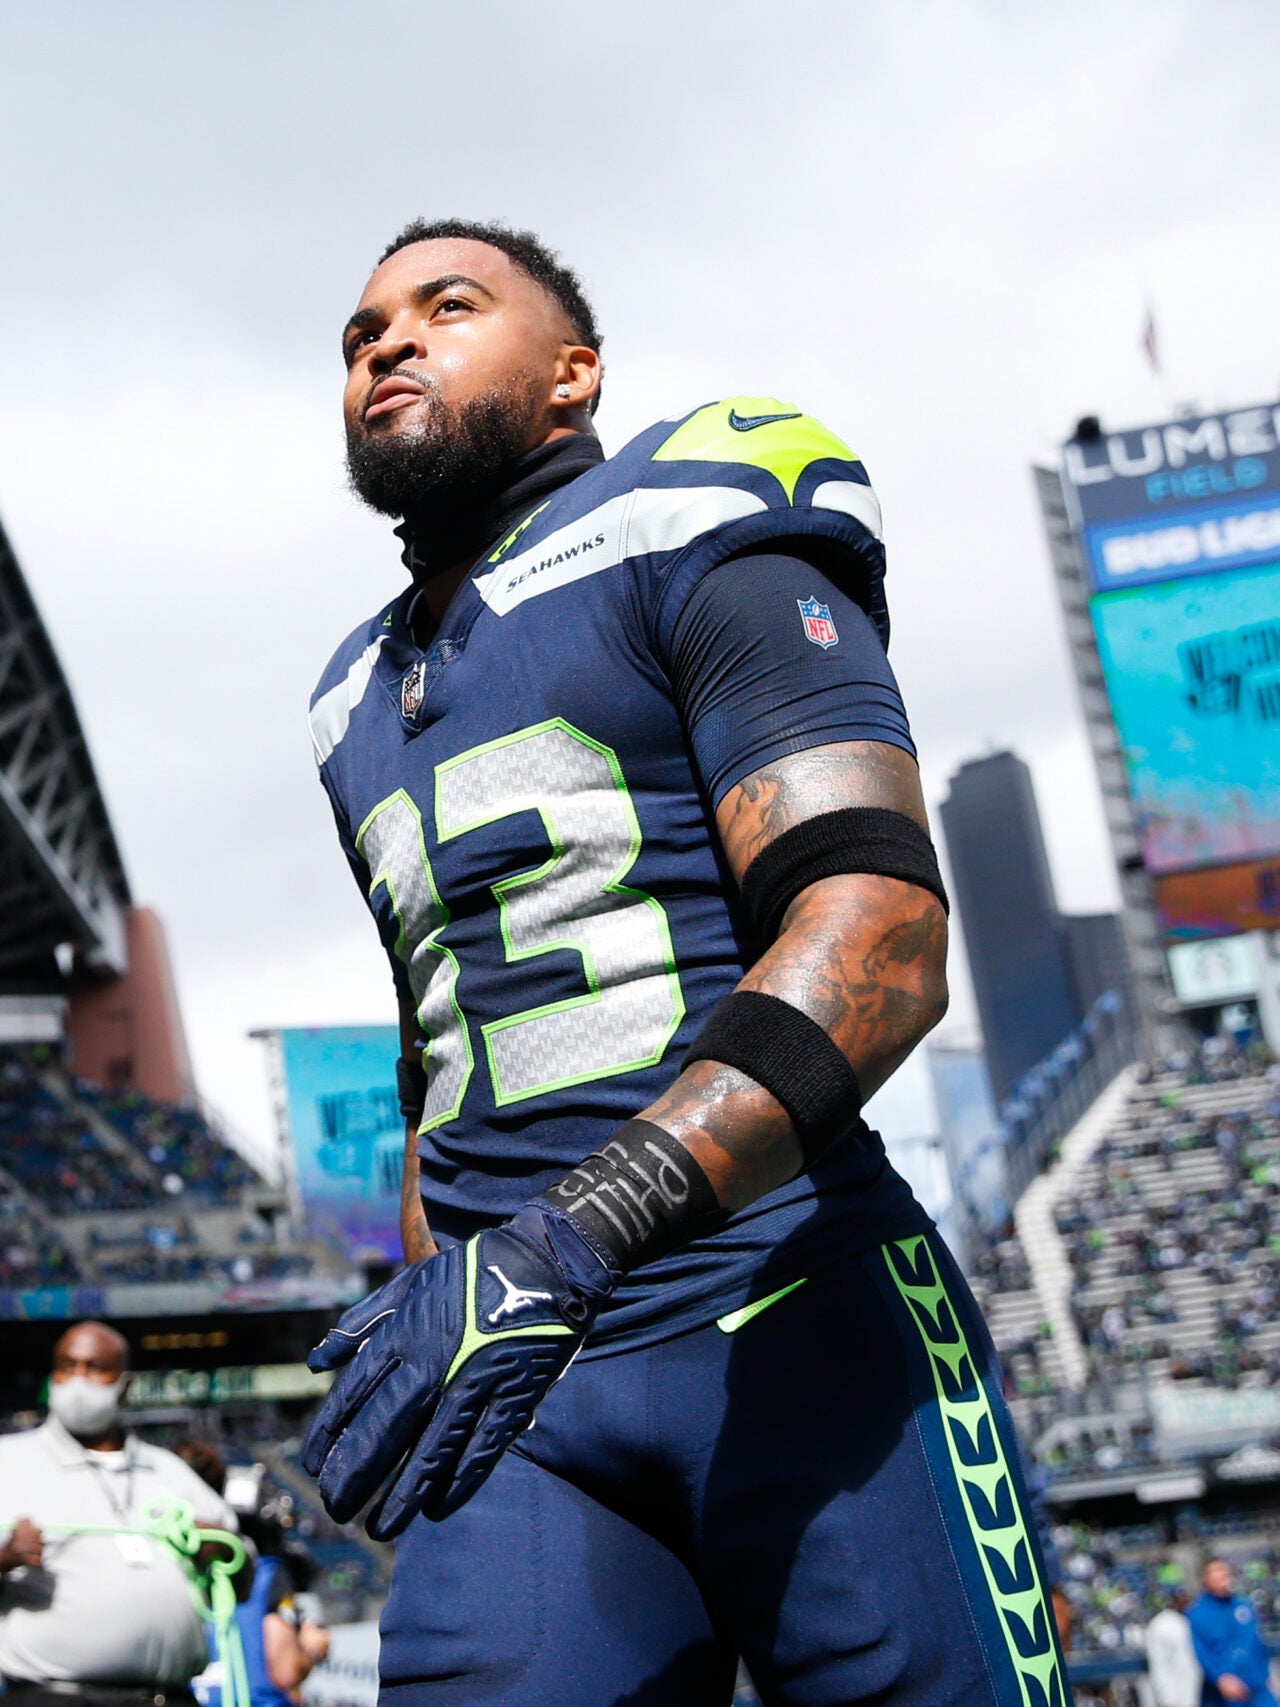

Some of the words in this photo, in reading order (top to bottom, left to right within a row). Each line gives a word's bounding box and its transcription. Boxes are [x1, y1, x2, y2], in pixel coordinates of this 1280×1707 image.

[1067, 405, 1280, 486] LUME
[1146, 456, 1268, 505] FIELD
[506, 533, 605, 593] SEAHAWKS
[806, 617, 835, 642] NFL
